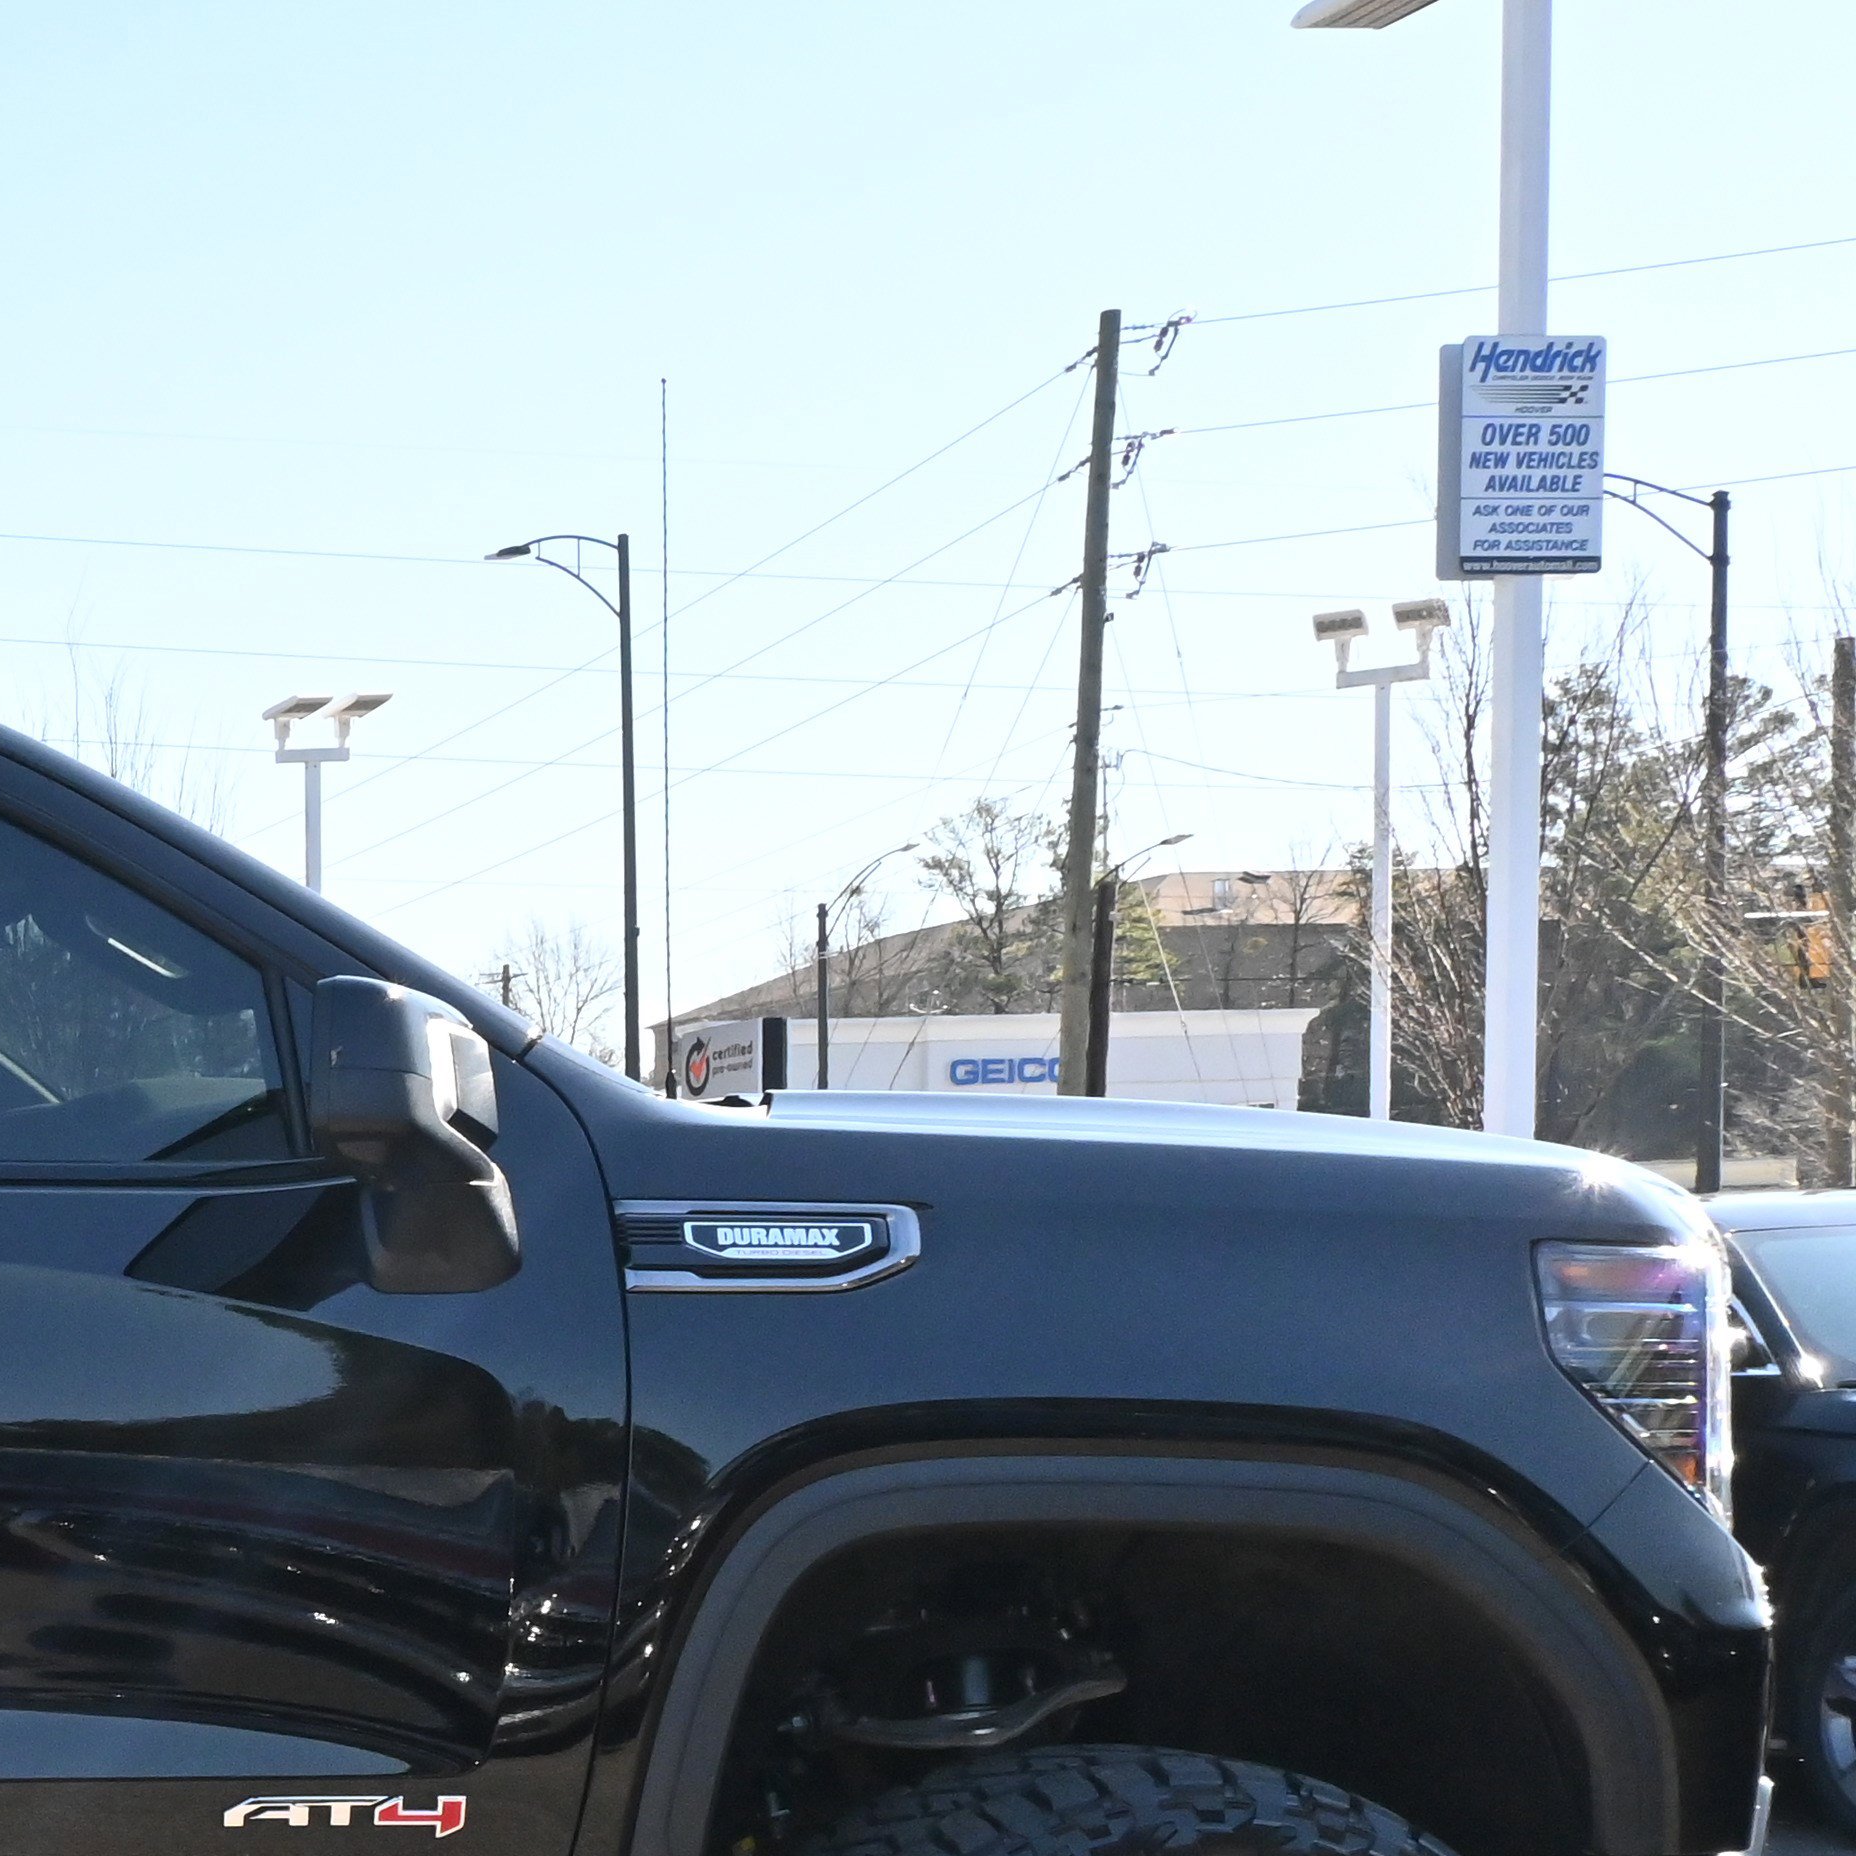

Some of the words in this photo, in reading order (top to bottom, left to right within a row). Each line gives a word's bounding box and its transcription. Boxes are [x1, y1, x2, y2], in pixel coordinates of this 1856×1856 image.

[1469, 341, 1602, 383] Hendrick
[1481, 423, 1541, 446] OVER
[1547, 423, 1590, 446] 500
[1469, 451, 1508, 469] NEW
[1515, 451, 1599, 469] VEHICLES
[1484, 474, 1583, 492] AVAILABLE
[1472, 504, 1500, 516] ASK
[1504, 504, 1533, 516] ONE
[1537, 504, 1557, 516] OF
[1561, 504, 1590, 516] OUR
[1488, 522, 1573, 534] ASSOCIATES
[1472, 539, 1501, 551] FOR
[1504, 539, 1589, 551] ASSISTANCE
[712, 1040, 753, 1060] certified
[717, 1227, 840, 1246] DURAMAX
[224, 1795, 467, 1838] AT4
